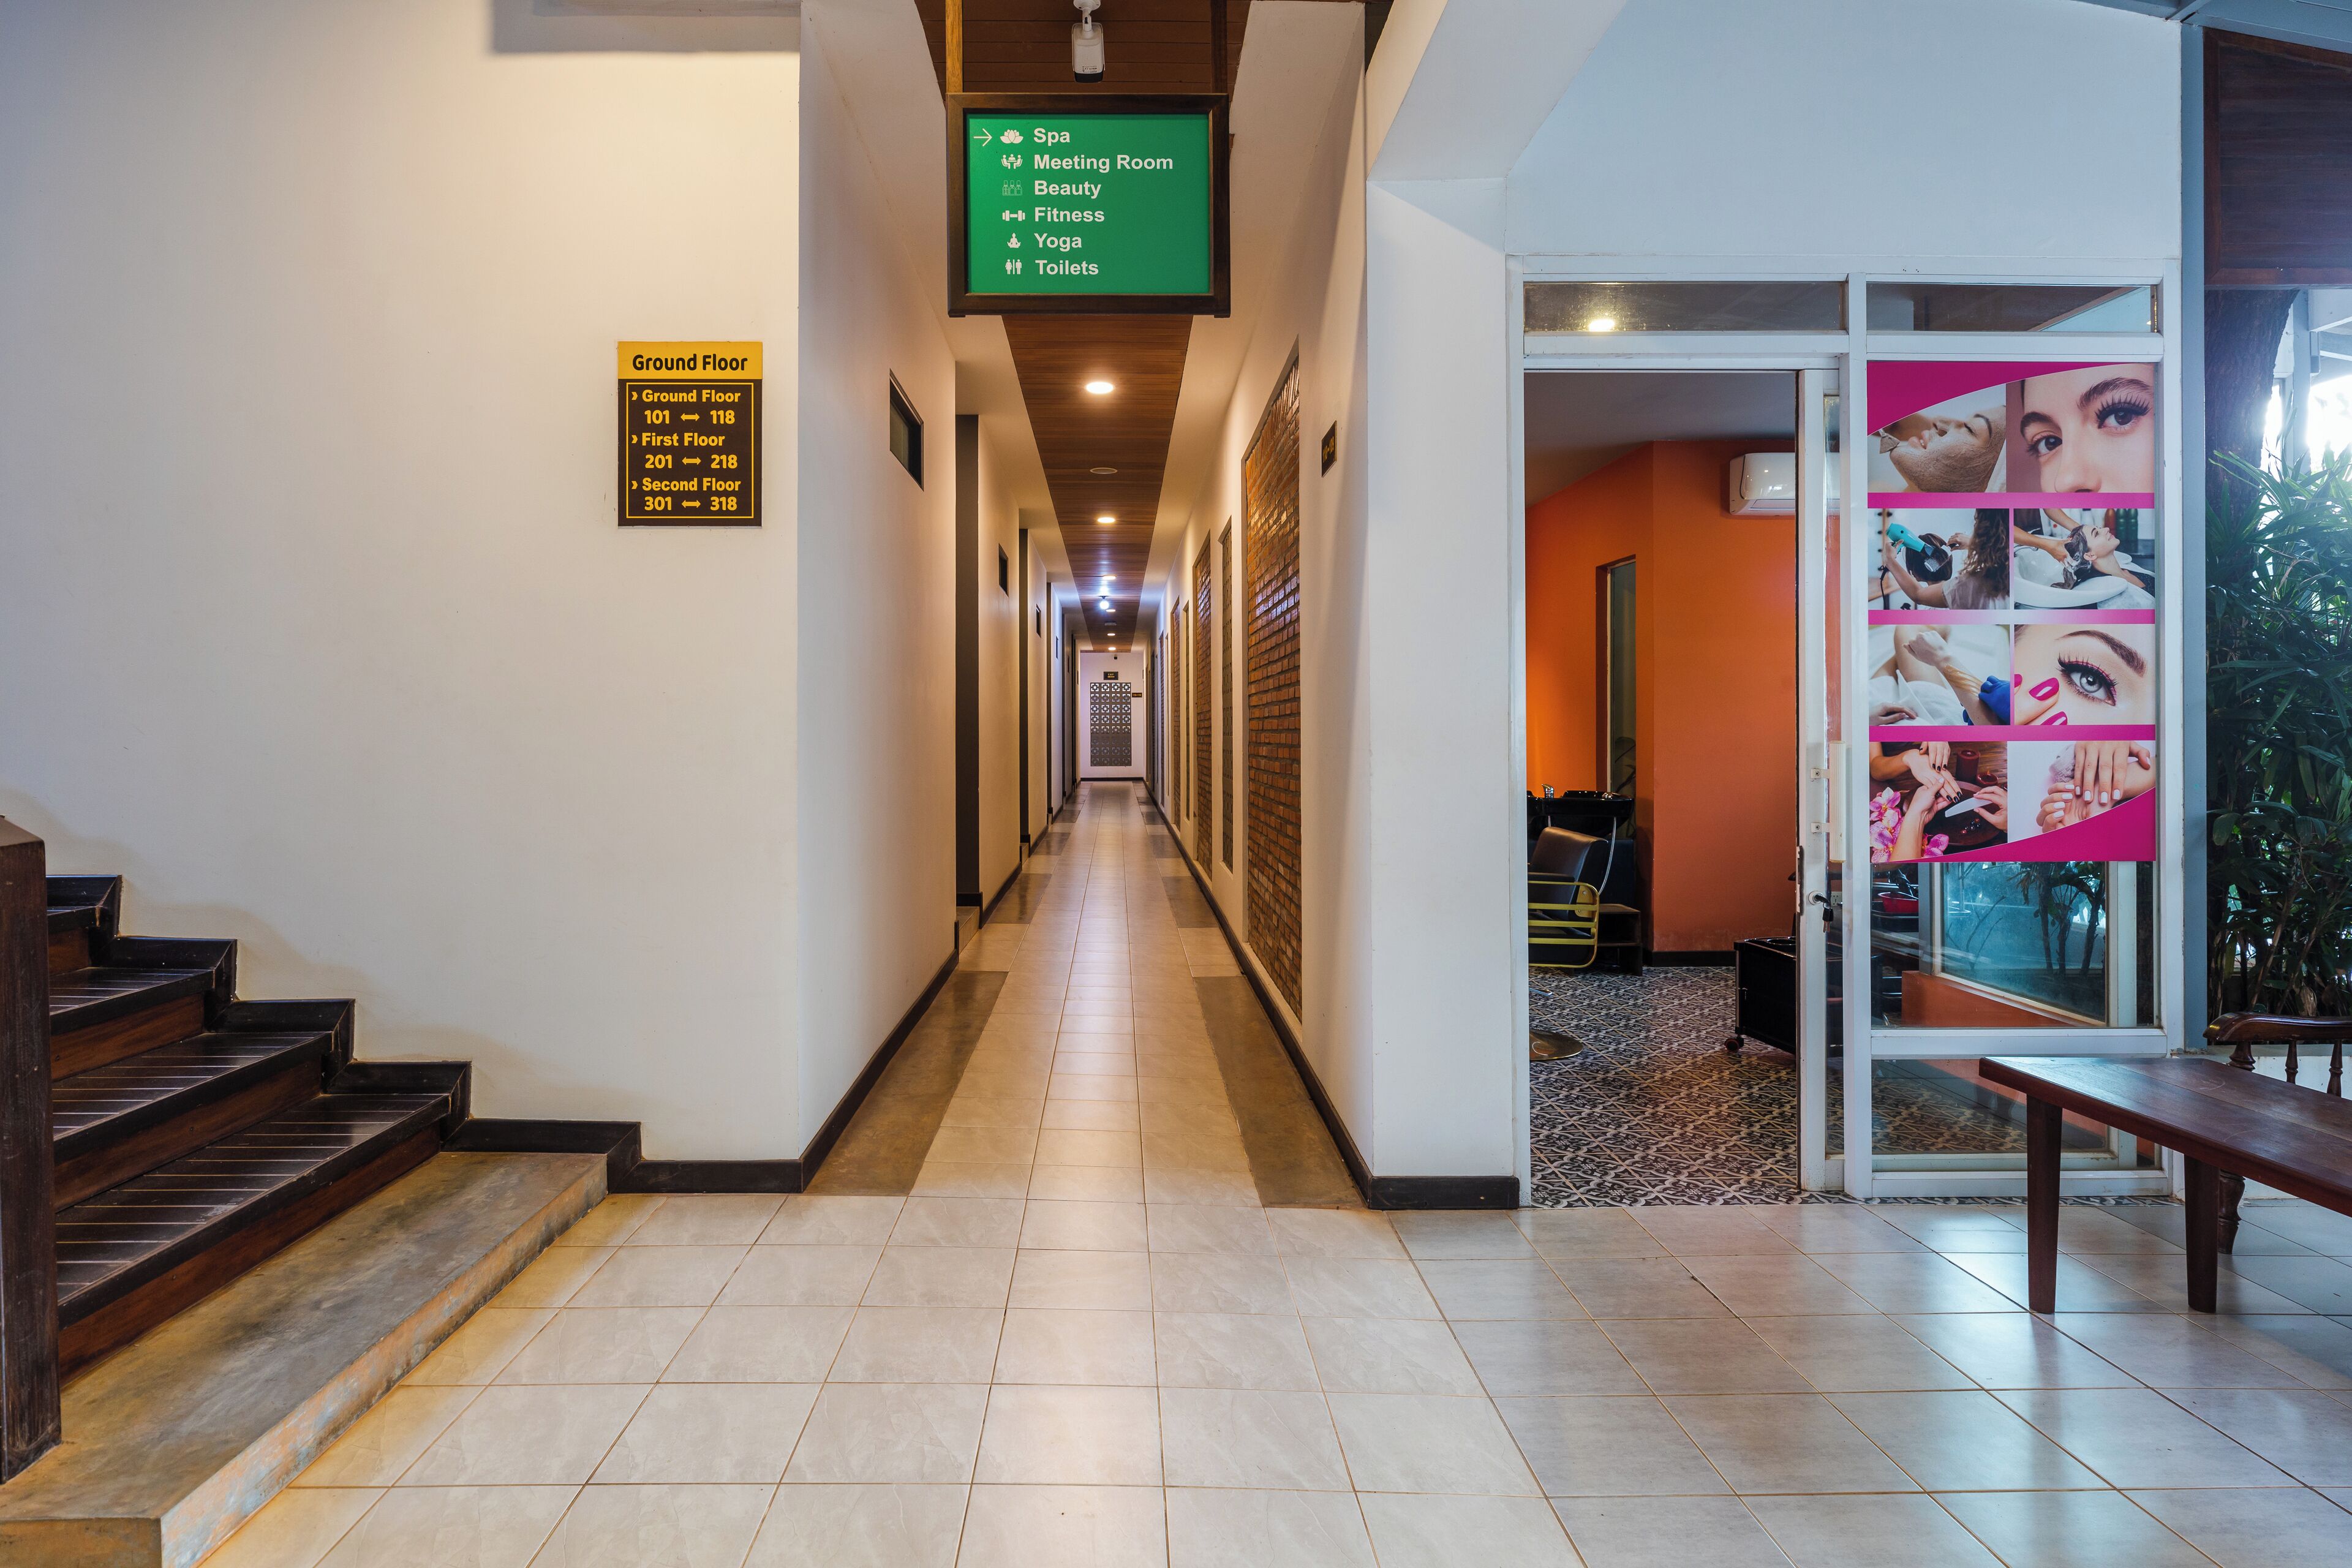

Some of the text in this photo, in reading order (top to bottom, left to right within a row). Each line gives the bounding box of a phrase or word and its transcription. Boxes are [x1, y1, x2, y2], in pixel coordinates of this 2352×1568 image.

[1033, 127, 1070, 146] Spa
[1034, 154, 1173, 173] Meeting Room
[1035, 180, 1102, 199] Beauty
[1035, 206, 1105, 222] Fitness
[1034, 233, 1082, 252] Yoga
[1035, 260, 1099, 275] Toilets
[632, 353, 748, 371] Ground Floor
[642, 389, 741, 402] Ground Floor
[644, 409, 736, 424] 101 118
[642, 432, 726, 447] First Floor
[644, 454, 738, 469] 201 218
[642, 477, 741, 491] Second Floor
[644, 496, 737, 511] 301 318
